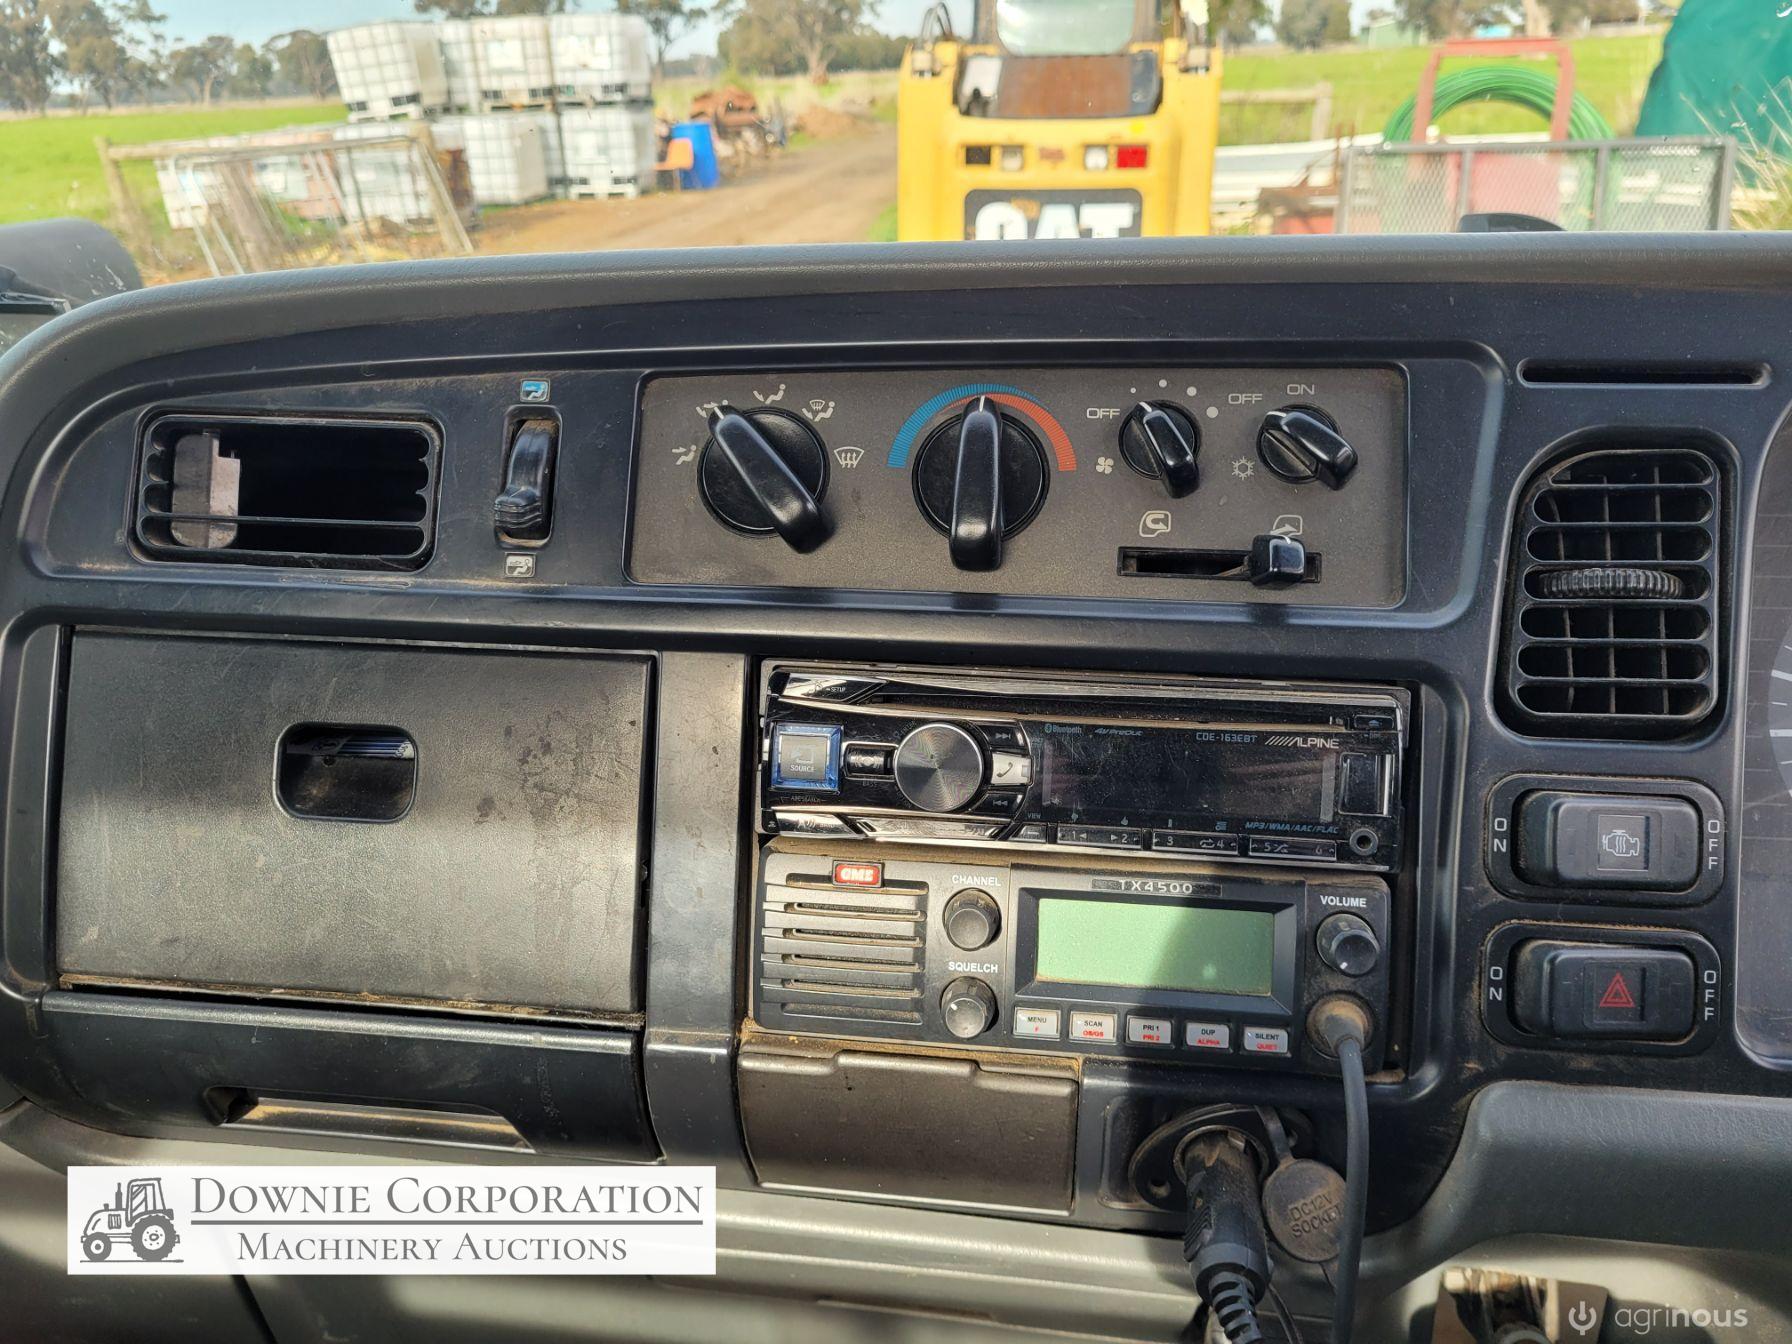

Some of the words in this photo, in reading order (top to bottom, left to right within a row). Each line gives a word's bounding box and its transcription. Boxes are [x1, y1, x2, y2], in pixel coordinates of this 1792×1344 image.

[1287, 384, 1315, 395] ON
[1228, 394, 1262, 405] OFF
[1086, 408, 1120, 419] OFF
[1196, 732, 1258, 743] CDE-163EBT
[790, 764, 816, 772] SOURCE
[1245, 822, 1339, 834] MP3/WMA/AAC/FLAC
[1121, 834, 1128, 843] 2
[1494, 818, 1507, 852] ON
[1166, 836, 1174, 846] 3
[1216, 840, 1224, 849] 4
[1707, 820, 1720, 869] OFF
[1264, 842, 1271, 852] 5
[951, 874, 1001, 887] CHANNEL
[1119, 880, 1193, 894] TX4500
[1320, 895, 1367, 908] VOLUME
[948, 961, 998, 973] SQUELCH
[1489, 966, 1503, 1001] ON
[1703, 970, 1716, 1020] OFF
[1201, 1028, 1216, 1036] DUP
[1255, 1033, 1279, 1041] SILENT
[1291, 1203, 1343, 1238] SOCKET
